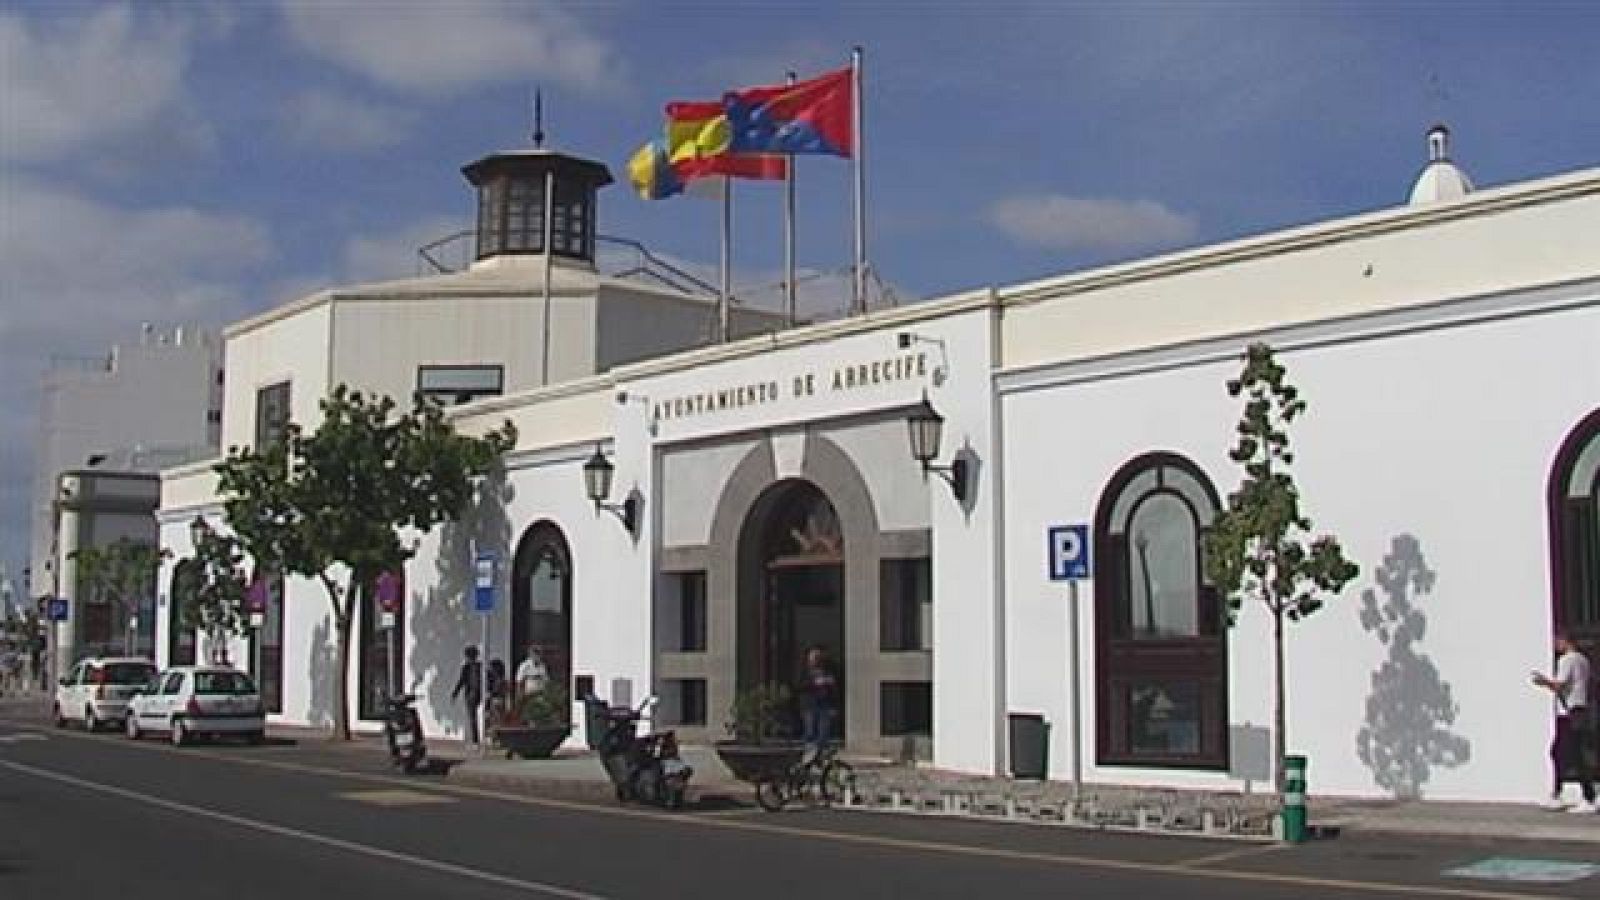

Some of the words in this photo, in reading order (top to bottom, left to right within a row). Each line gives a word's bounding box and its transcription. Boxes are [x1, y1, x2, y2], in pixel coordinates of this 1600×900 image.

[653, 381, 778, 420] AYUNTAMIENTO
[793, 374, 814, 397] DE
[832, 352, 928, 391] ARRECIFE
[1054, 531, 1081, 576] P
